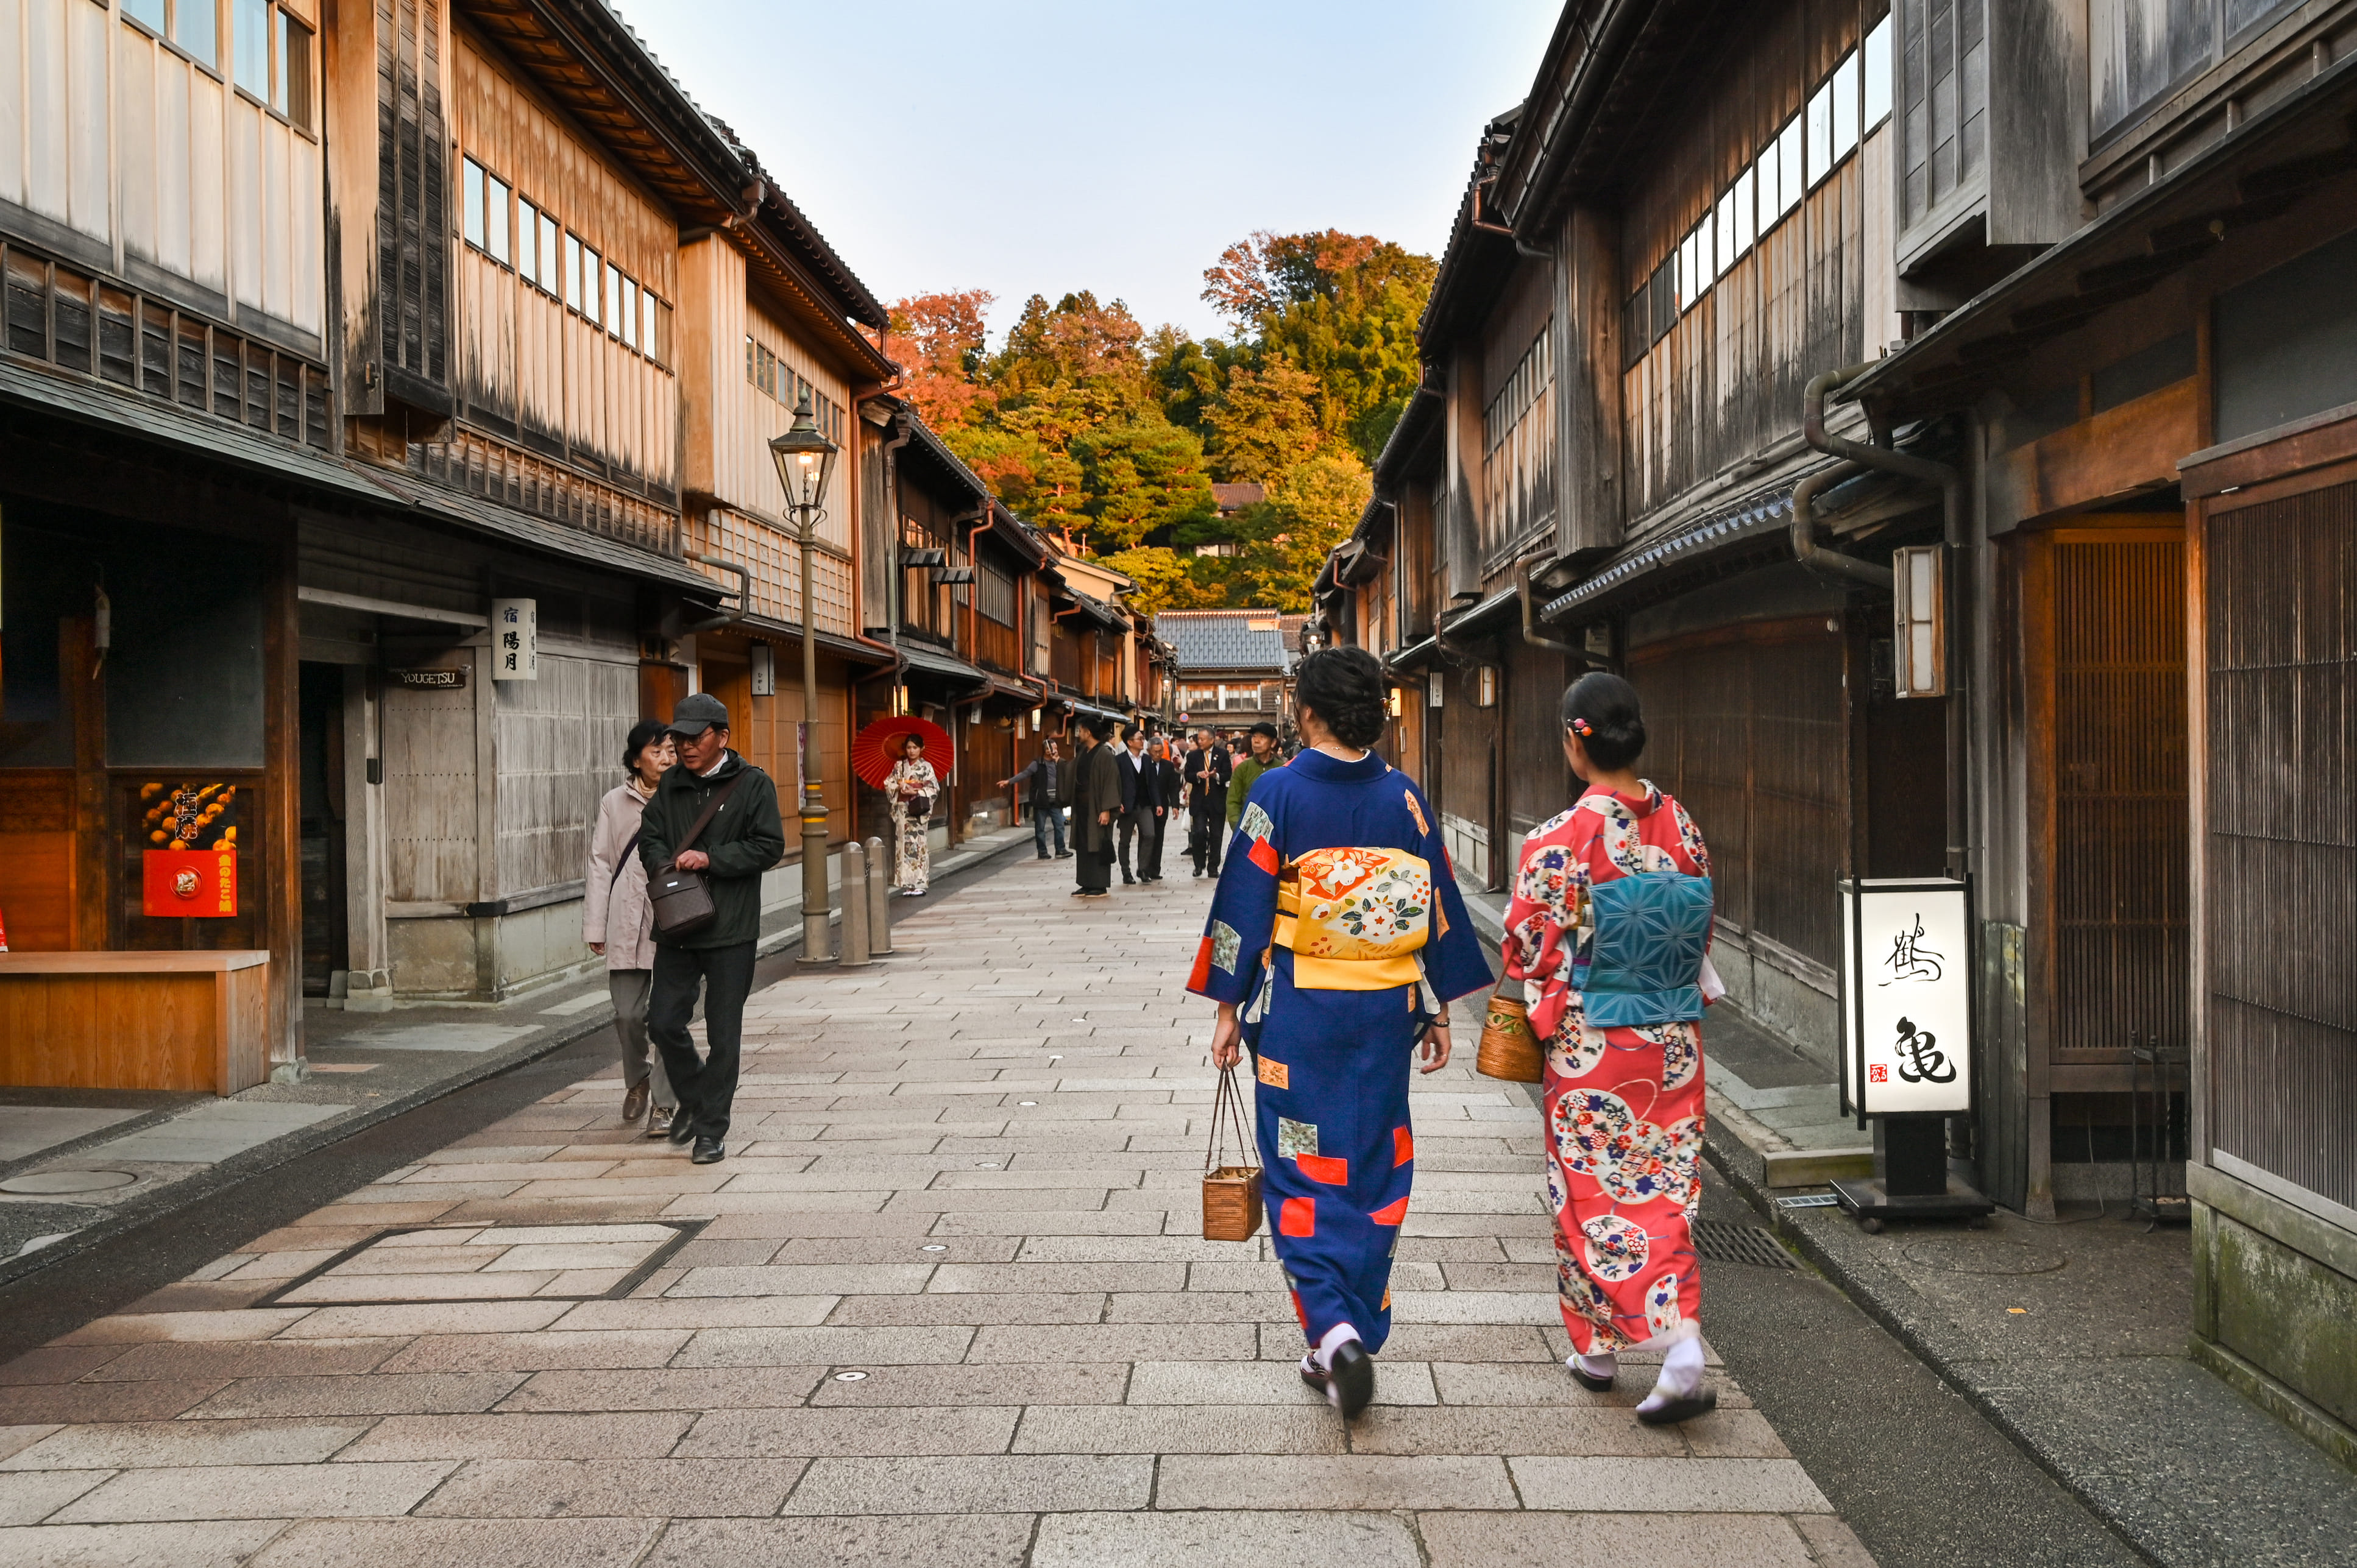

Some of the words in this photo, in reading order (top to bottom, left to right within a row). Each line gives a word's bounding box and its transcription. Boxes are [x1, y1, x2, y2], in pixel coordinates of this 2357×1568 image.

[503, 607, 520, 671] 宿陽月
[401, 673, 455, 684] YOUGETSU
